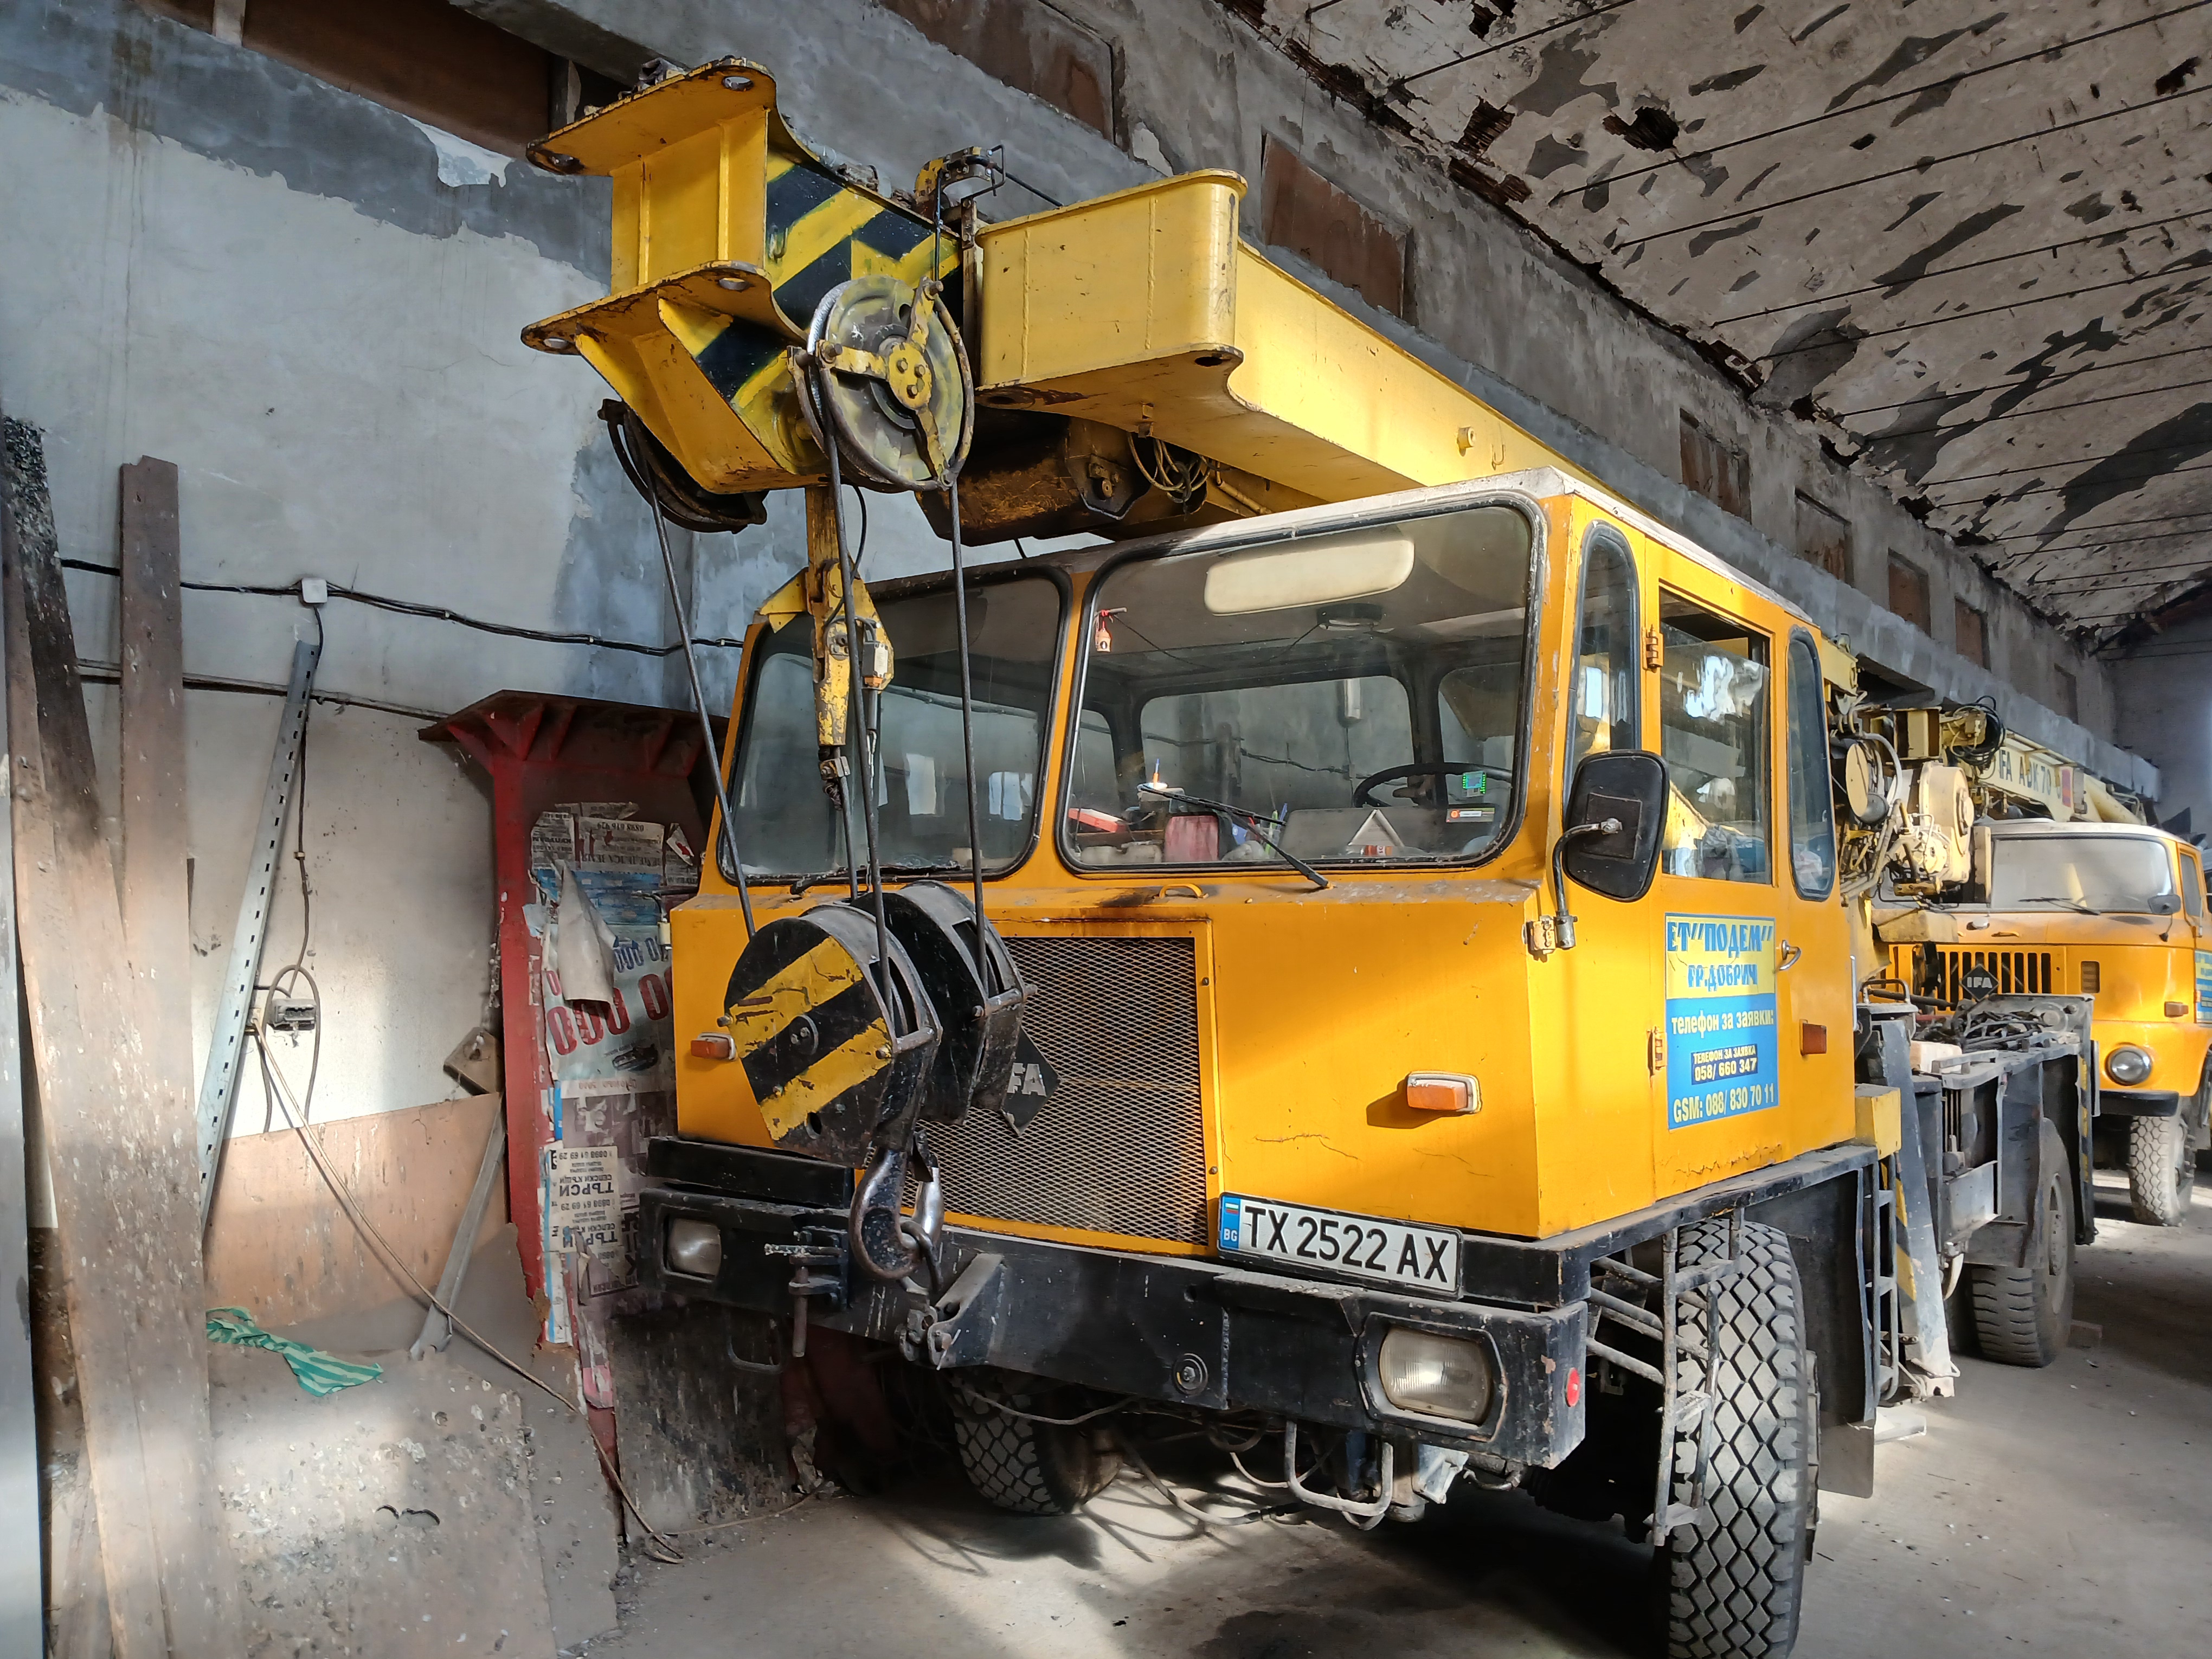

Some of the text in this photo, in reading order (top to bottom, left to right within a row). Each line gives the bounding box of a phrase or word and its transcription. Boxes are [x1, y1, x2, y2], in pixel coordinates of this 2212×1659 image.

[1966, 976, 1993, 988] IFA
[1671, 1009, 1774, 1038] телефон за заявки:
[1693, 1044, 1756, 1065] ТЕЛЕФОН ЗА ЗАЯВКА
[1007, 1062, 1047, 1097] FA
[1694, 1057, 1758, 1082] 058/ 660 347
[1673, 1083, 1774, 1123] GSM: 088/ 830 70 11
[559, 1181, 614, 1197] ТЪРСИ
[563, 1231, 618, 1248] ТЪРИ
[1224, 1228, 1238, 1242] BG
